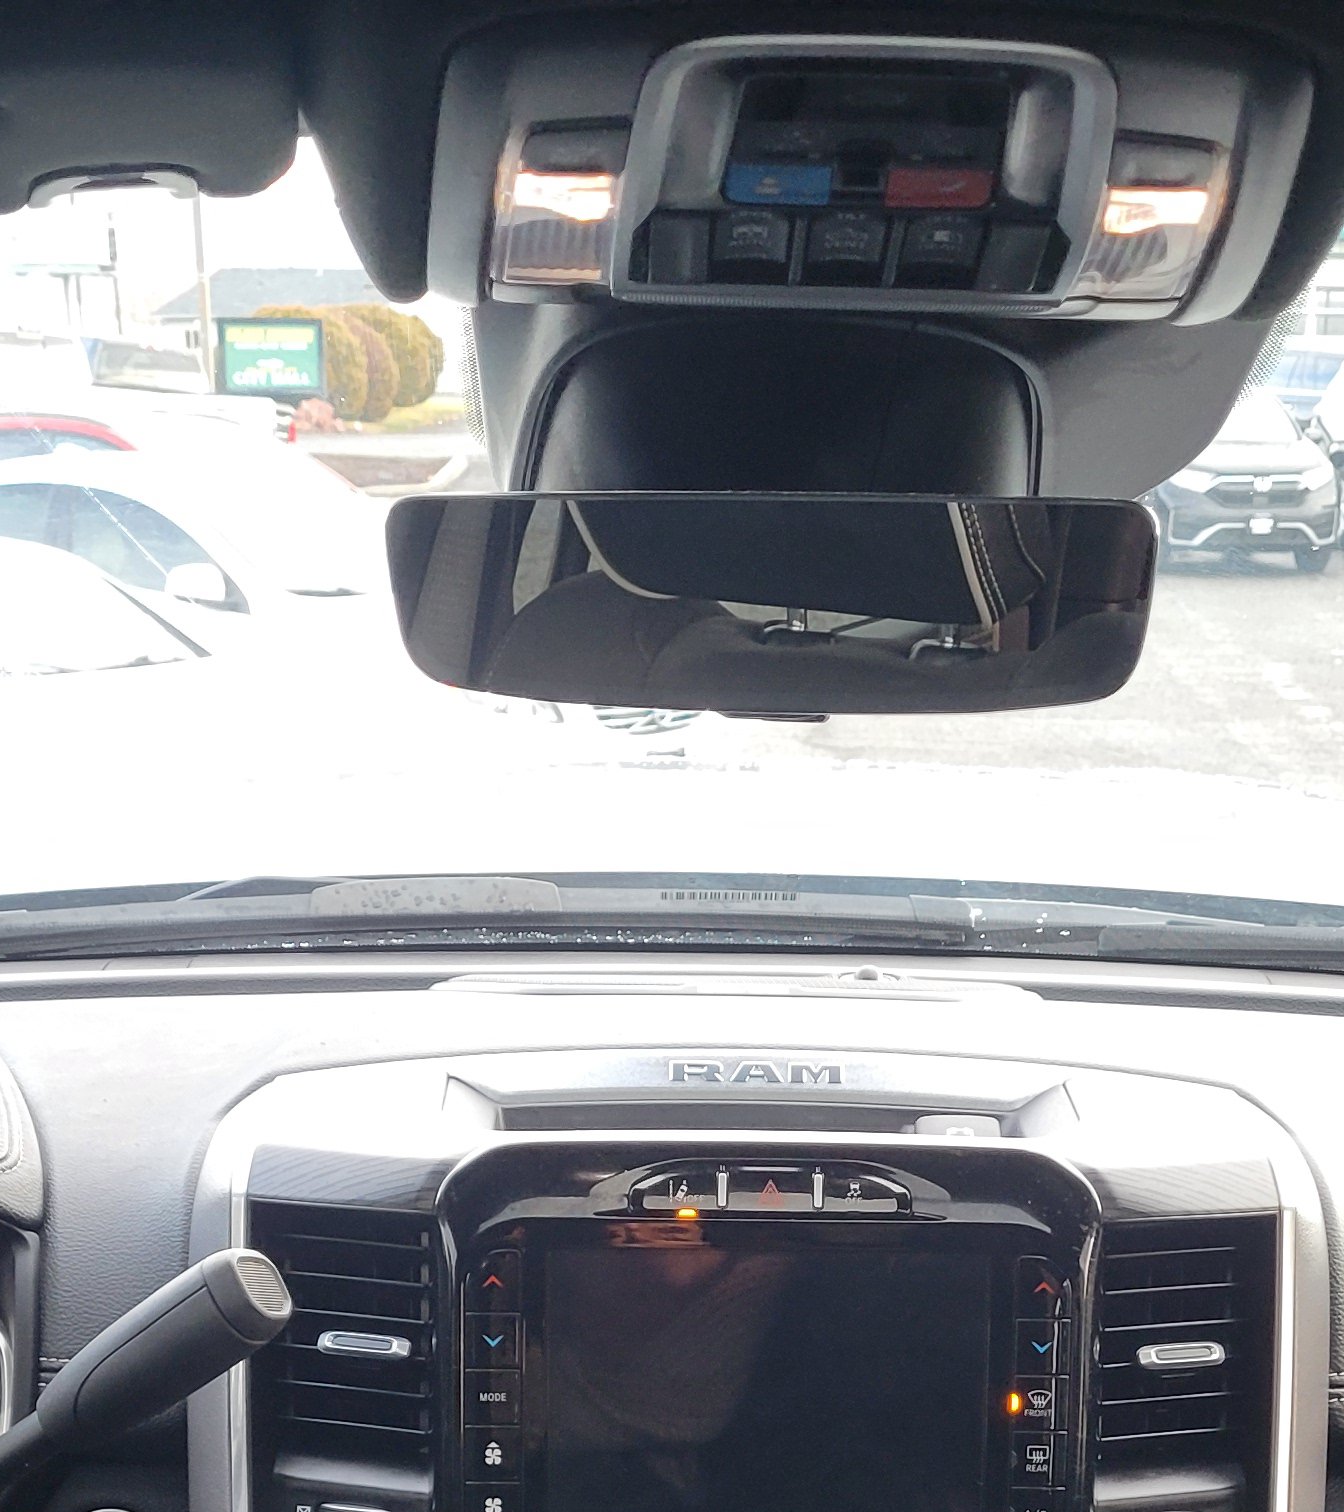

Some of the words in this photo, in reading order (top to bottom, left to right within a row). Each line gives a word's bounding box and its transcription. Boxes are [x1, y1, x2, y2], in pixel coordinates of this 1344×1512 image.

[668, 1059, 845, 1084] RAM
[479, 1392, 507, 1402] MODE
[1025, 1464, 1048, 1473] REAR
